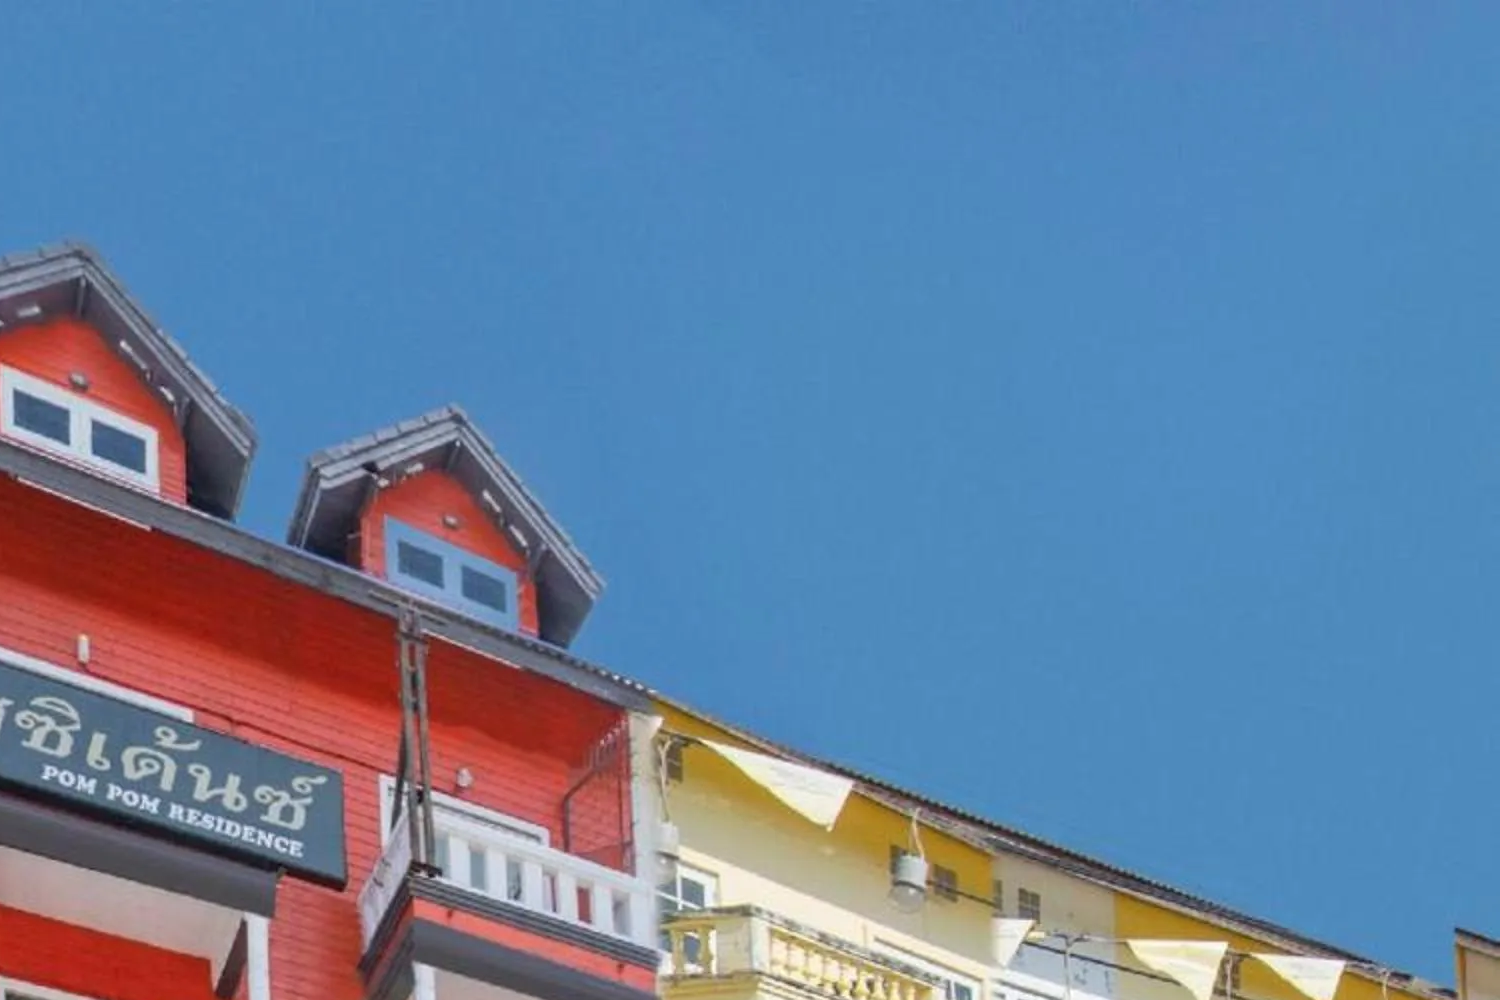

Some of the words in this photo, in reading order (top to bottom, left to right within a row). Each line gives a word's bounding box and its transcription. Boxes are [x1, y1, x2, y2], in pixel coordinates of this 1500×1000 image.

[41, 763, 98, 797] POM
[106, 782, 162, 815] POM
[167, 803, 305, 859] RESIDENCE
